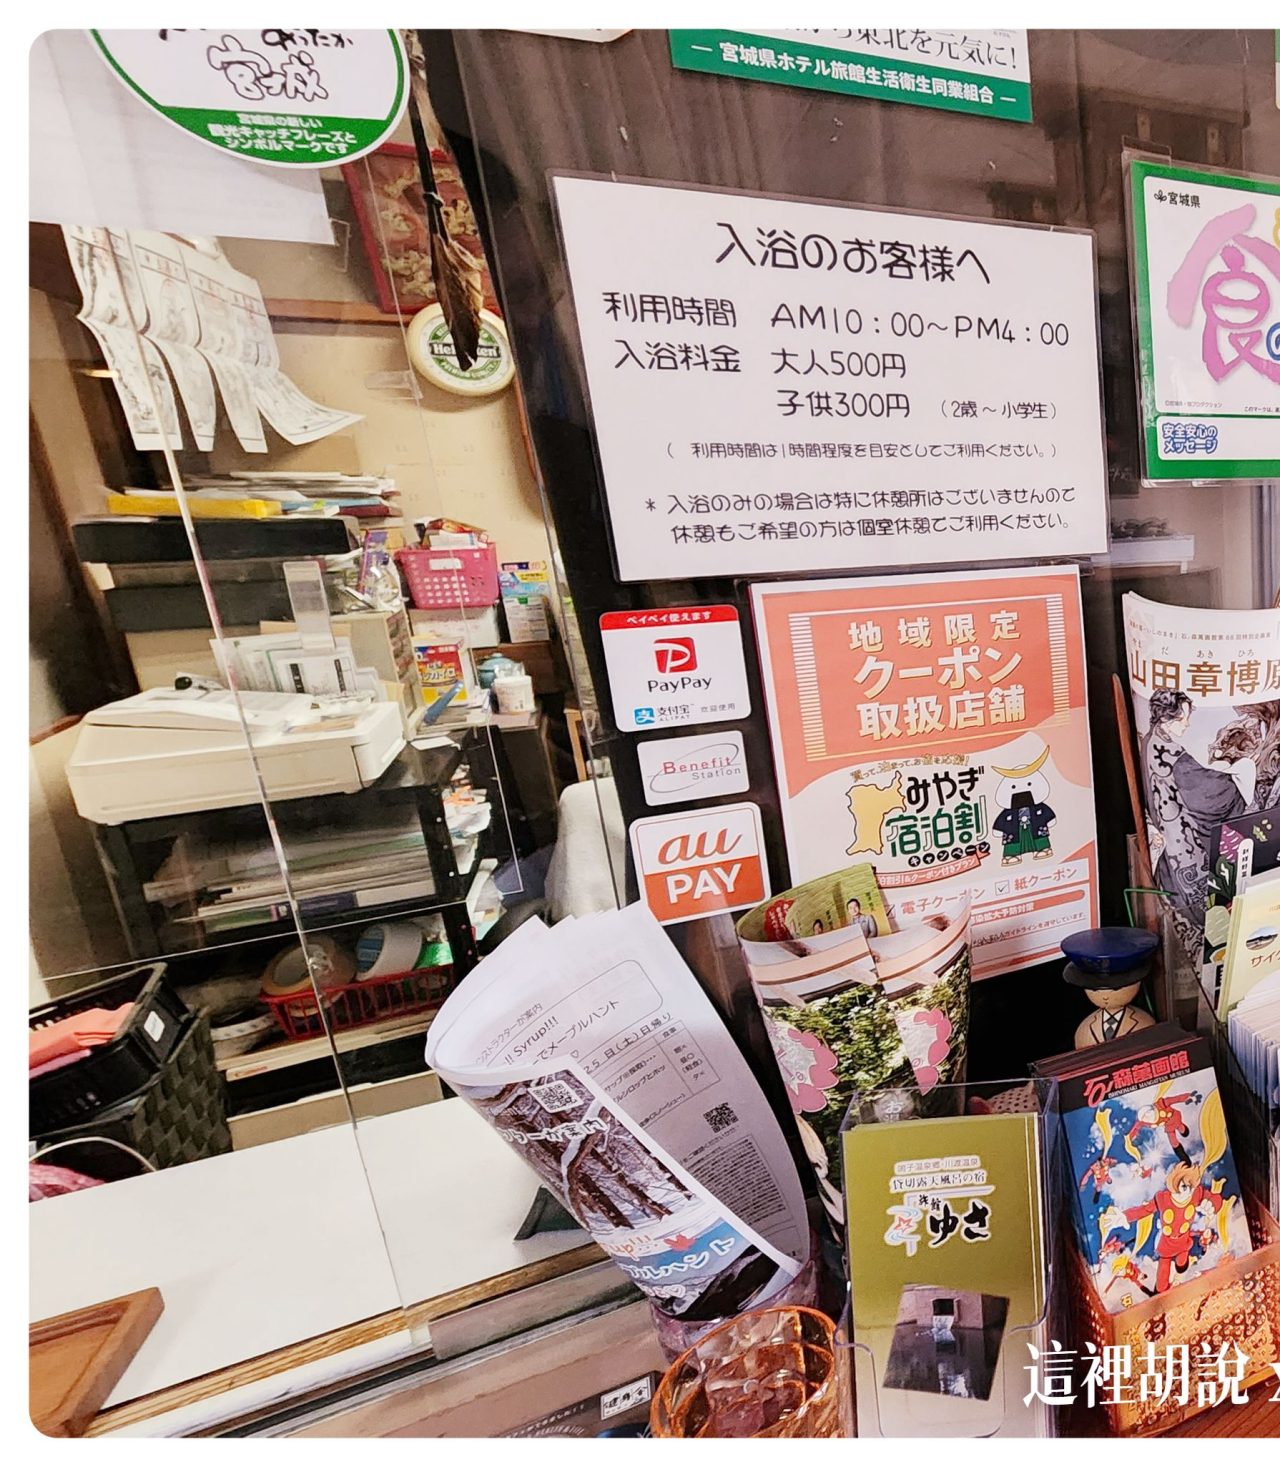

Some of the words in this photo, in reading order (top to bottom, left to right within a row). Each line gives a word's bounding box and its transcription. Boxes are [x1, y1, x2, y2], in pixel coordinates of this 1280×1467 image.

[719, 42, 995, 104] 宮城県ホテル旅館生活衛生同業組合
[224, 136, 349, 155] シンボルマークです
[1167, 191, 1201, 209] 宮城県
[715, 222, 992, 284] 入浴のお客様へ
[602, 292, 737, 329] 利用時間
[613, 340, 742, 373] 入浴料金
[771, 348, 907, 378] 大人500円
[776, 389, 911, 419] 子供300円
[1162, 422, 1218, 438] 安全安心の
[1164, 438, 1218, 454] メッセージ
[671, 514, 1072, 544] 休憩もご希望の方は個室休憩でご利用ください。
[848, 609, 1021, 653] 地域限定
[647, 676, 712, 693] PayPay
[853, 645, 1023, 699] クーポン
[657, 704, 690, 717] 支付宝
[856, 684, 1026, 741] 取扱店舗
[662, 756, 732, 775] Benefit
[692, 767, 741, 781] Station
[906, 766, 985, 814] みやぎ
[885, 795, 989, 858] 宿泊割
[657, 828, 743, 865] au
[908, 841, 991, 868] キャンペーン
[666, 863, 742, 904] PAY
[1014, 868, 1078, 891] 紙クーポン
[513, 1015, 560, 1058] Syrup!!!
[892, 1171, 986, 1191] 貸切露天風呂の宿
[929, 1201, 990, 1246] ゆさ
